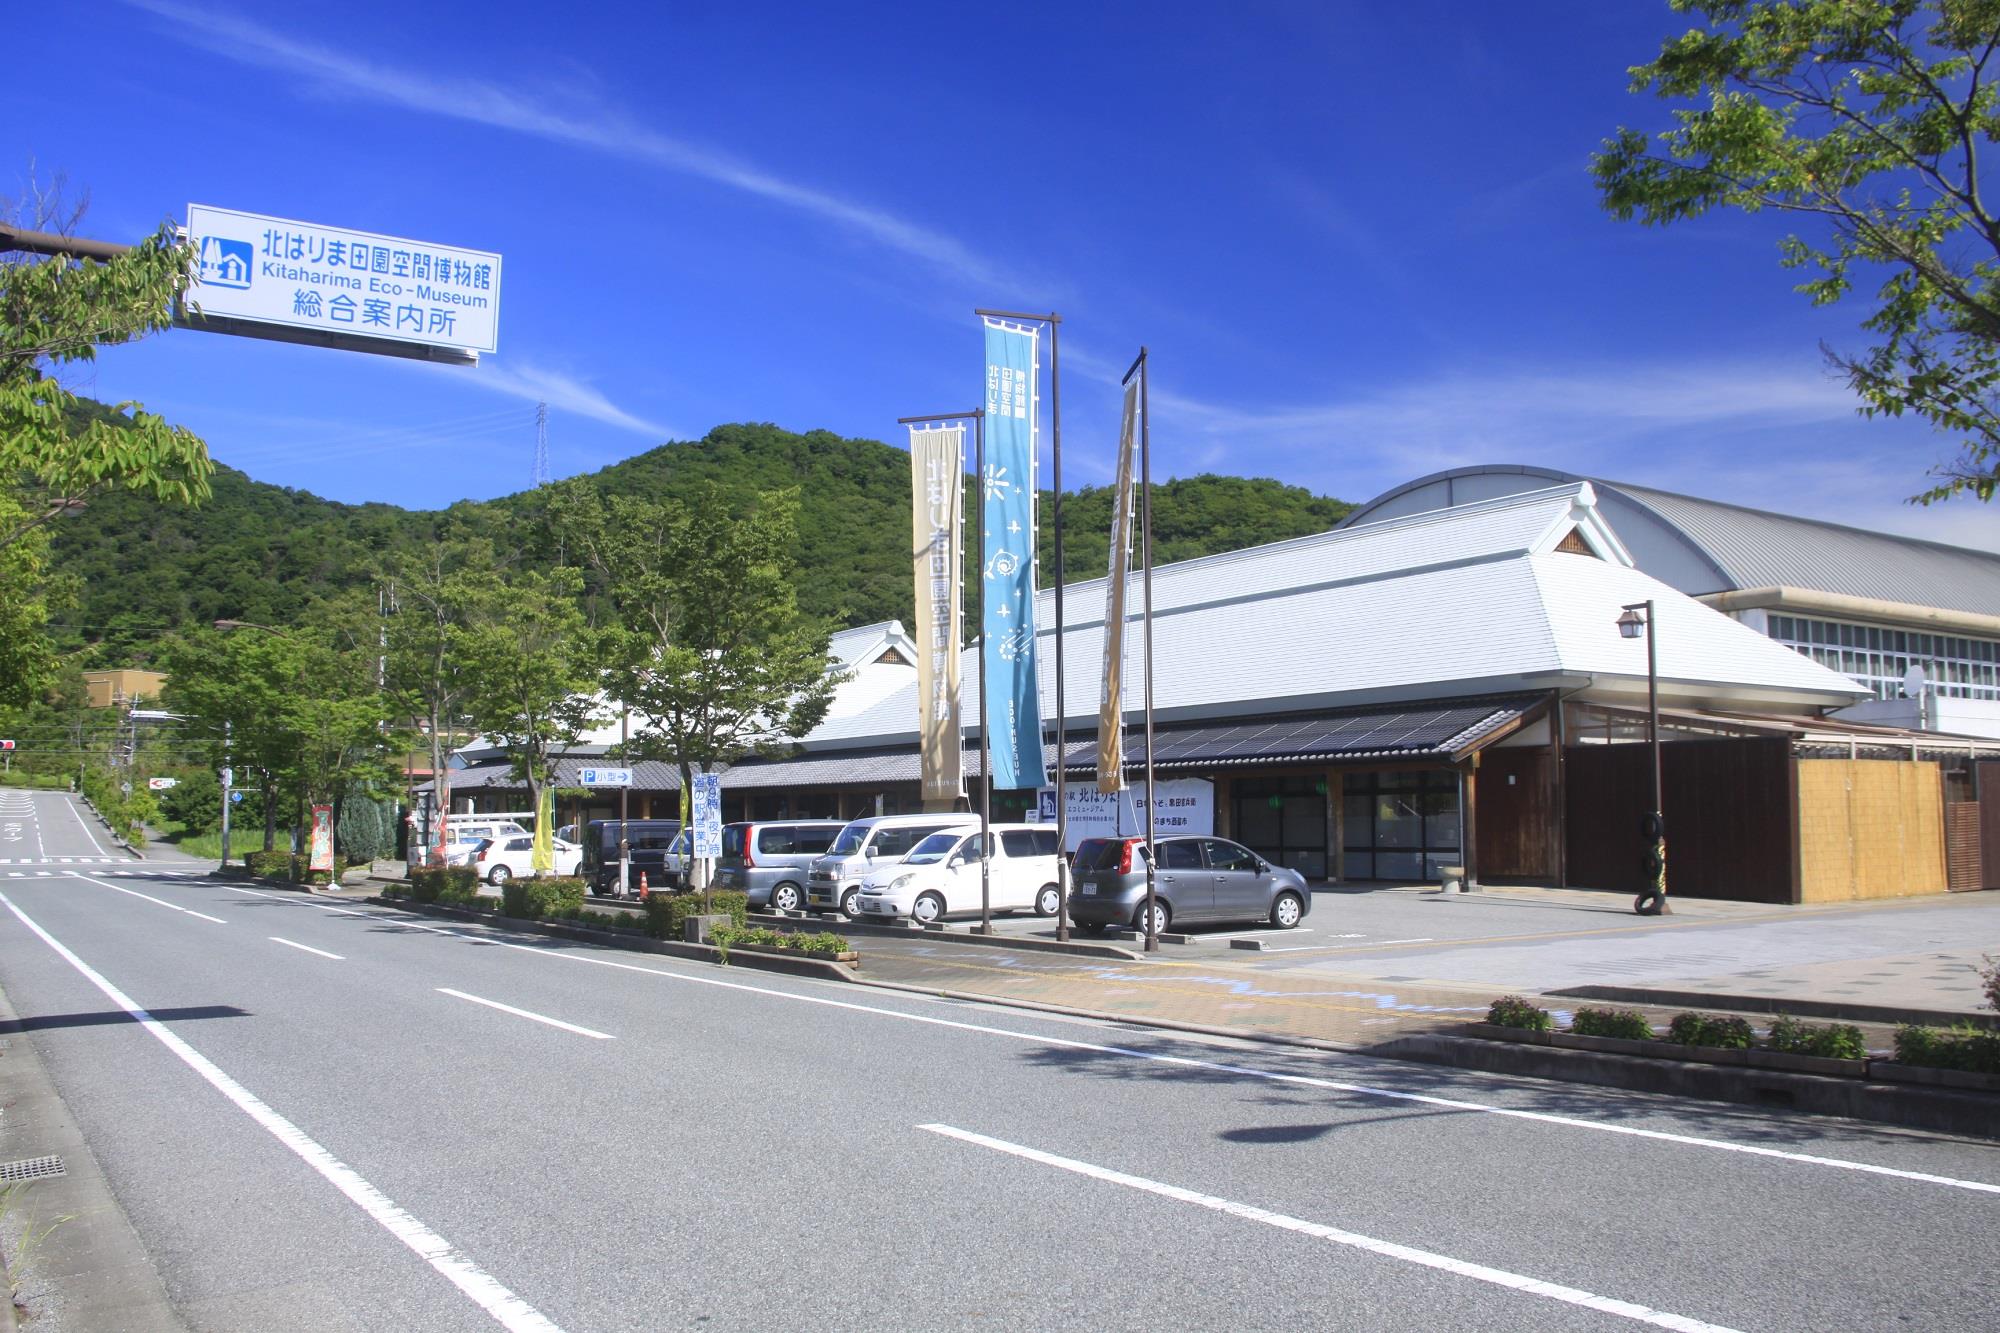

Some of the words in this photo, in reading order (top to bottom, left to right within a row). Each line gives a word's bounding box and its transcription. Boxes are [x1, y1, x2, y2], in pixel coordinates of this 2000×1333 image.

[261, 228, 491, 290] 北はりま田園空間博物館
[261, 261, 362, 290] Kitaharima
[293, 287, 457, 337] 総合案内所
[597, 772, 616, 782] 小型
[693, 776, 707, 856] 道の駅営業中
